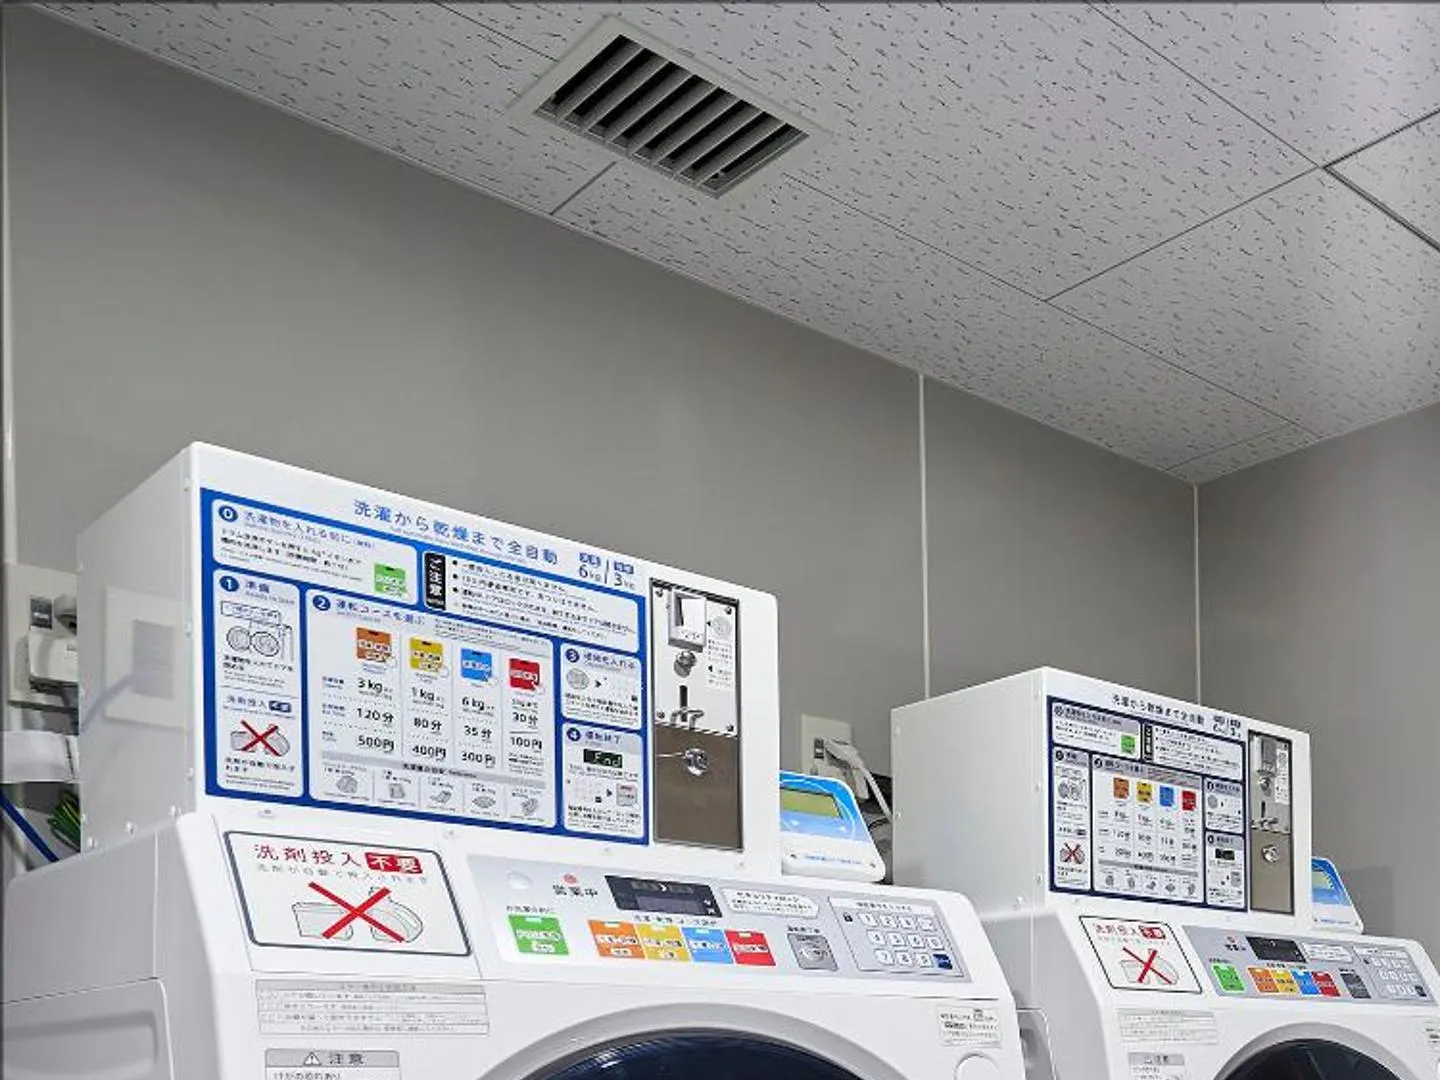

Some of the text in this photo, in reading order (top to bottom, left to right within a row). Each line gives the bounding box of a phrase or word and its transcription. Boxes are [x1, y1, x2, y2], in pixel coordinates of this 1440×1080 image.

[353, 500, 558, 565] 洗濯から乾燥まで全自動
[357, 708, 394, 723] 120分
[358, 736, 394, 750] 500円
[510, 736, 542, 750] 100円
[412, 745, 446, 759] 400円
[255, 844, 361, 867] 洗剤投入
[329, 1052, 364, 1065] 注意
